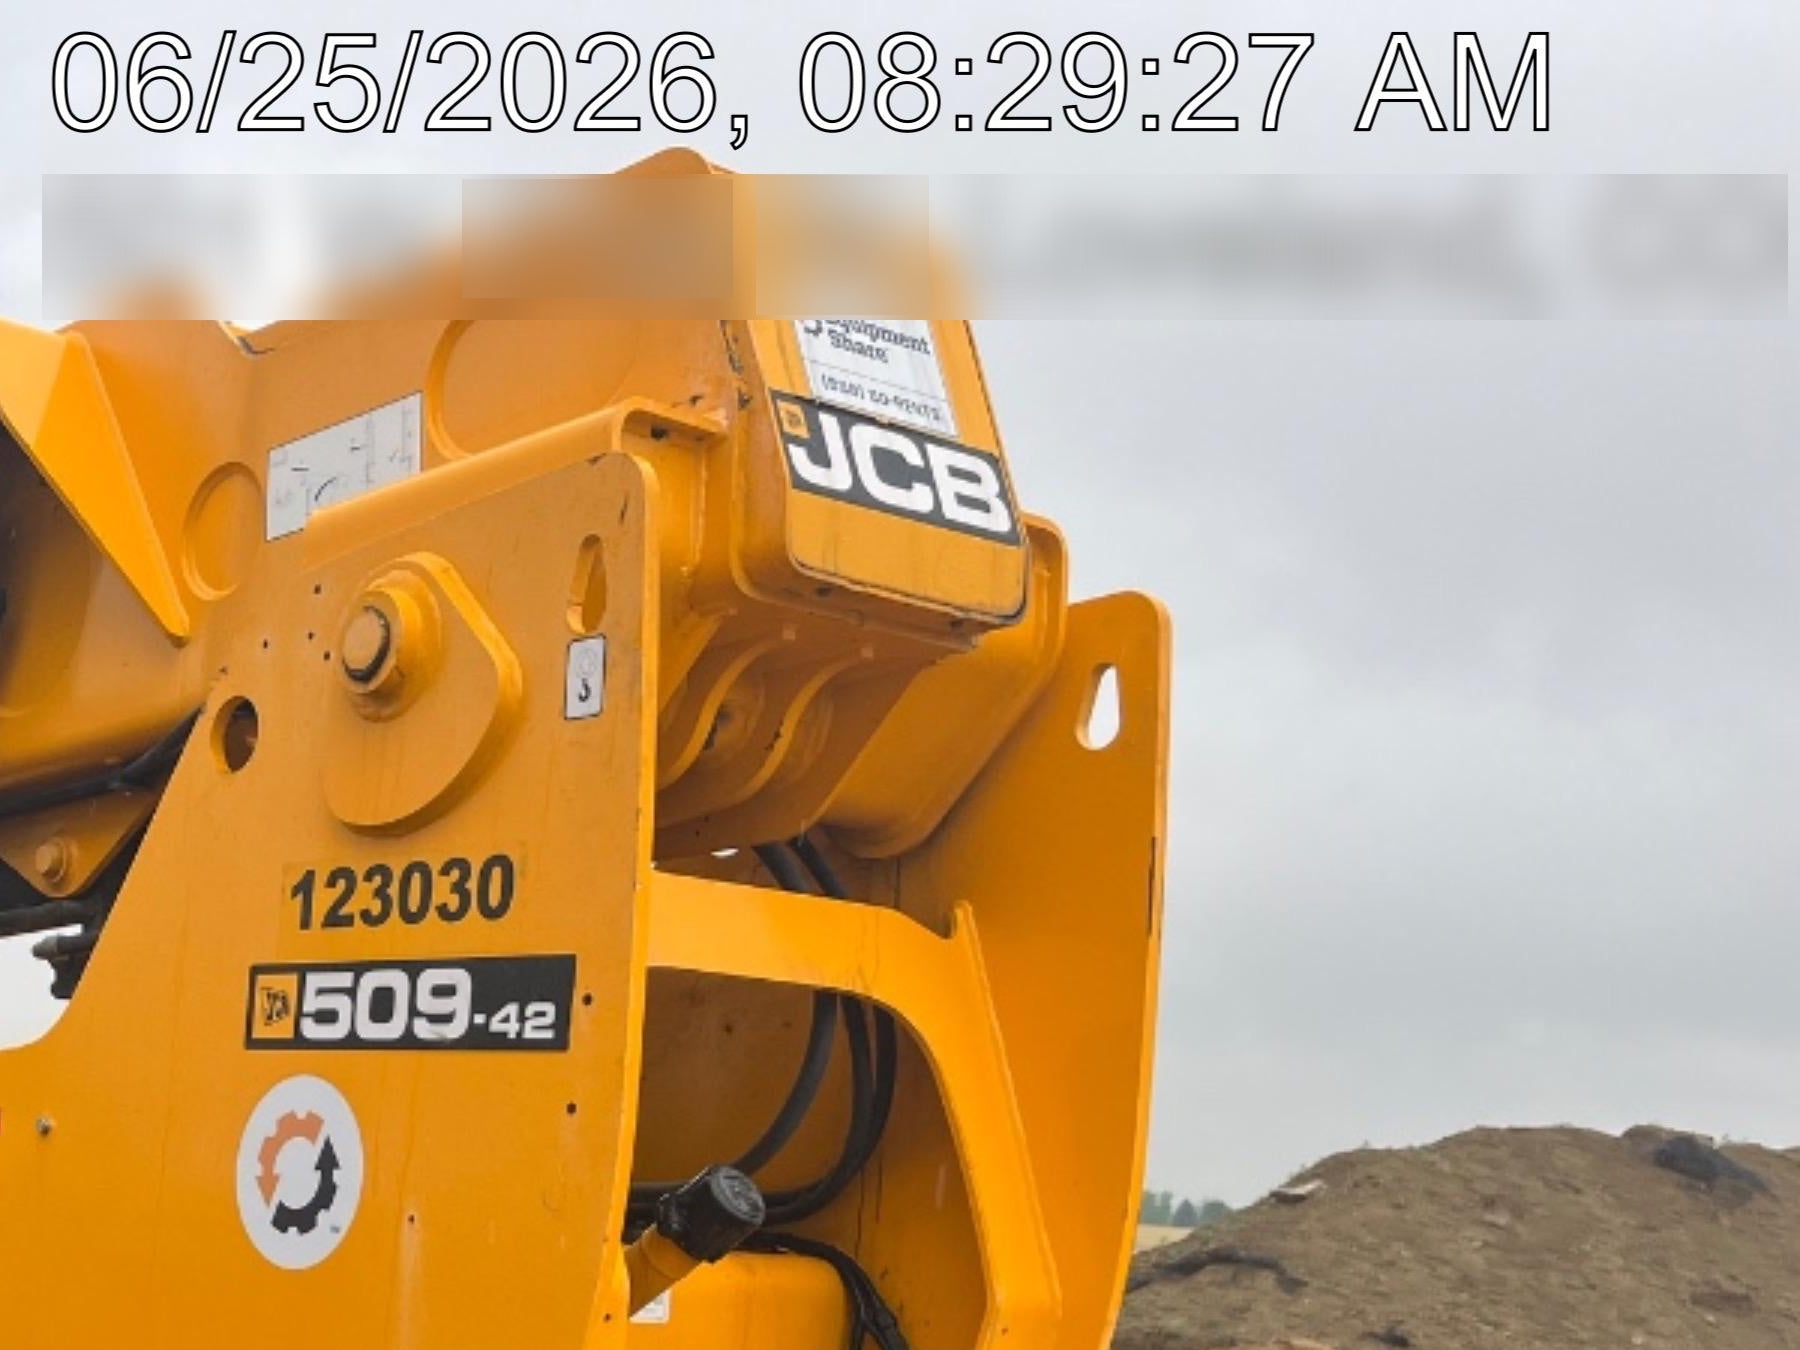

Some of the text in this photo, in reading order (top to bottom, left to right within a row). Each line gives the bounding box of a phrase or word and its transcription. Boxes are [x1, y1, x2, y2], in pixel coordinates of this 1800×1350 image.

[788, 411, 1012, 533] JCB
[290, 854, 514, 930] 123030
[300, 968, 556, 1041] 509-42
